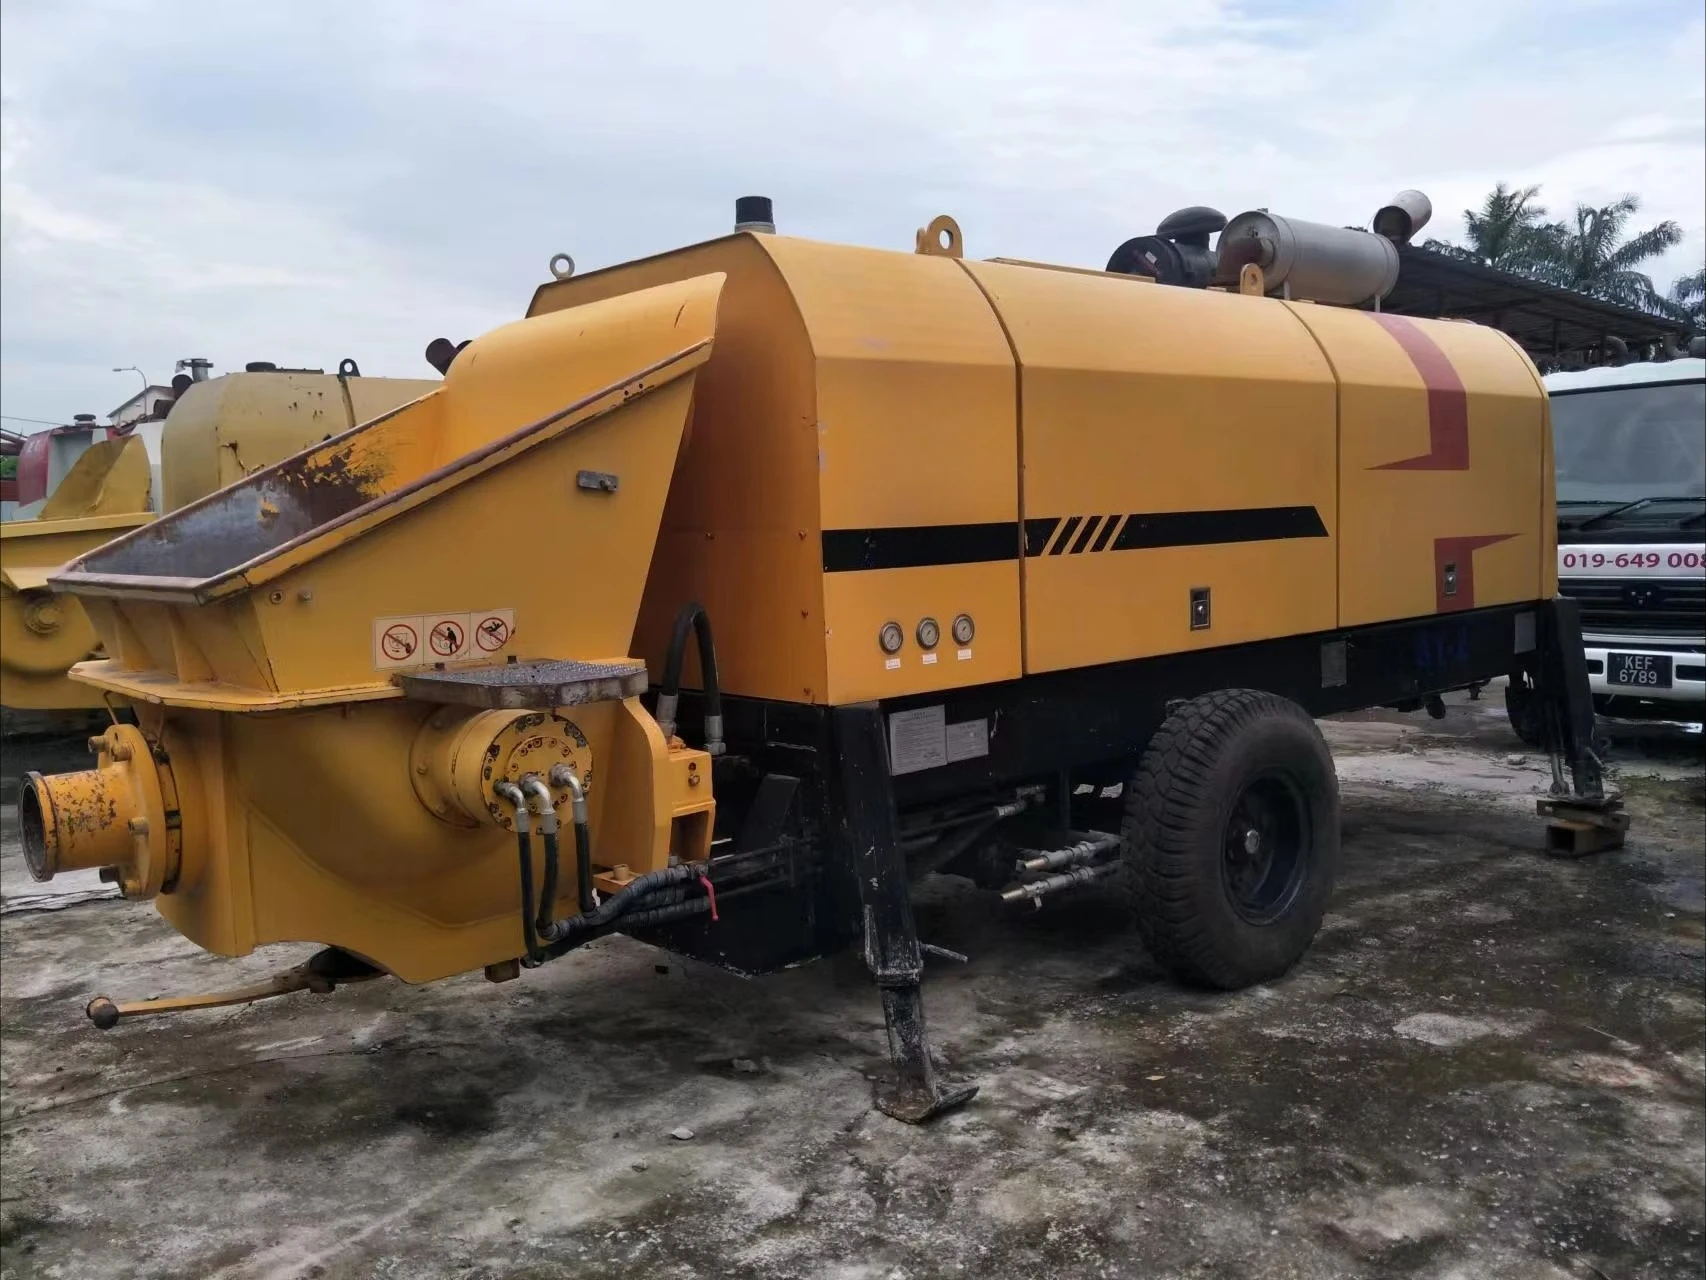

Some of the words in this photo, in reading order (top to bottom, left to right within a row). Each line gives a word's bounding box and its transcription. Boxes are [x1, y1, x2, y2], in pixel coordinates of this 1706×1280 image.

[1563, 553, 1661, 568] 019-649
[1625, 655, 1653, 670] KEF
[1620, 669, 1657, 684] 6789
